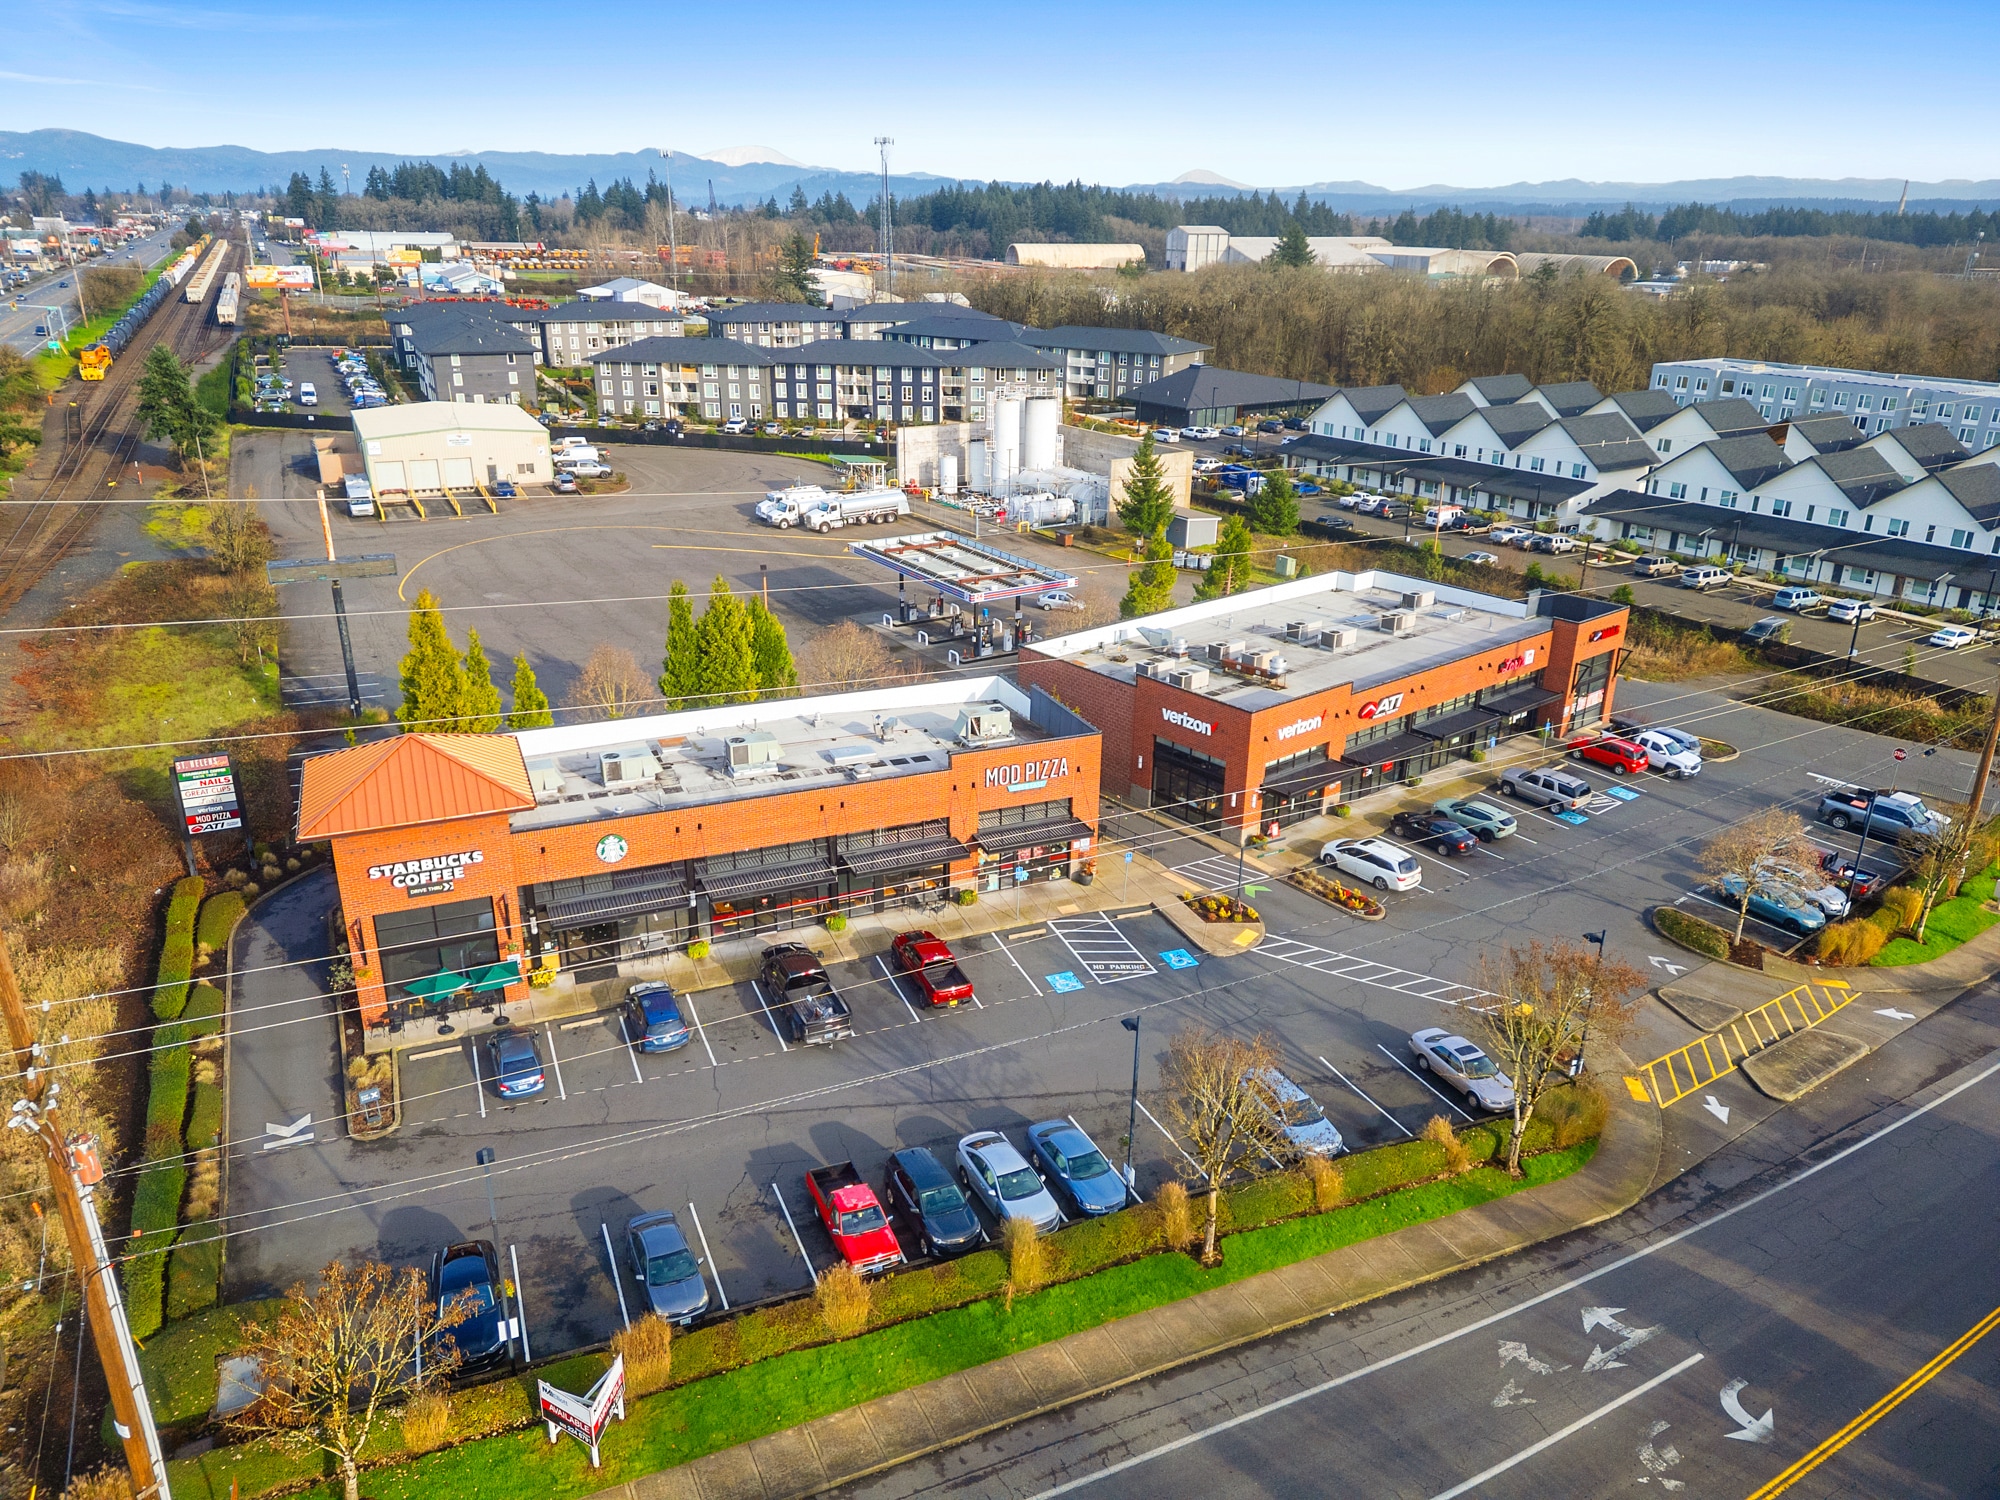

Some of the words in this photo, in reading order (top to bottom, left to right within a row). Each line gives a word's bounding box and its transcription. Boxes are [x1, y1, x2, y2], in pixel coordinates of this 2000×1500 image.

[1375, 692, 1404, 714] ATI
[1162, 707, 1212, 736] verizon
[1277, 715, 1322, 741] verizon
[200, 776, 231, 787] NAILS
[985, 764, 1021, 788] MOD
[1025, 757, 1069, 782] PIZZA
[185, 788, 209, 798] GREAT
[211, 785, 231, 793] CLIPS
[195, 814, 211, 824] MOD
[212, 811, 231, 821] PIZZA
[198, 805, 224, 814] verizon
[203, 822, 225, 831] ATI
[368, 849, 484, 880] STARBUCKS
[392, 867, 465, 888] COFFEE
[549, 1404, 591, 1435] AVAILABLE
